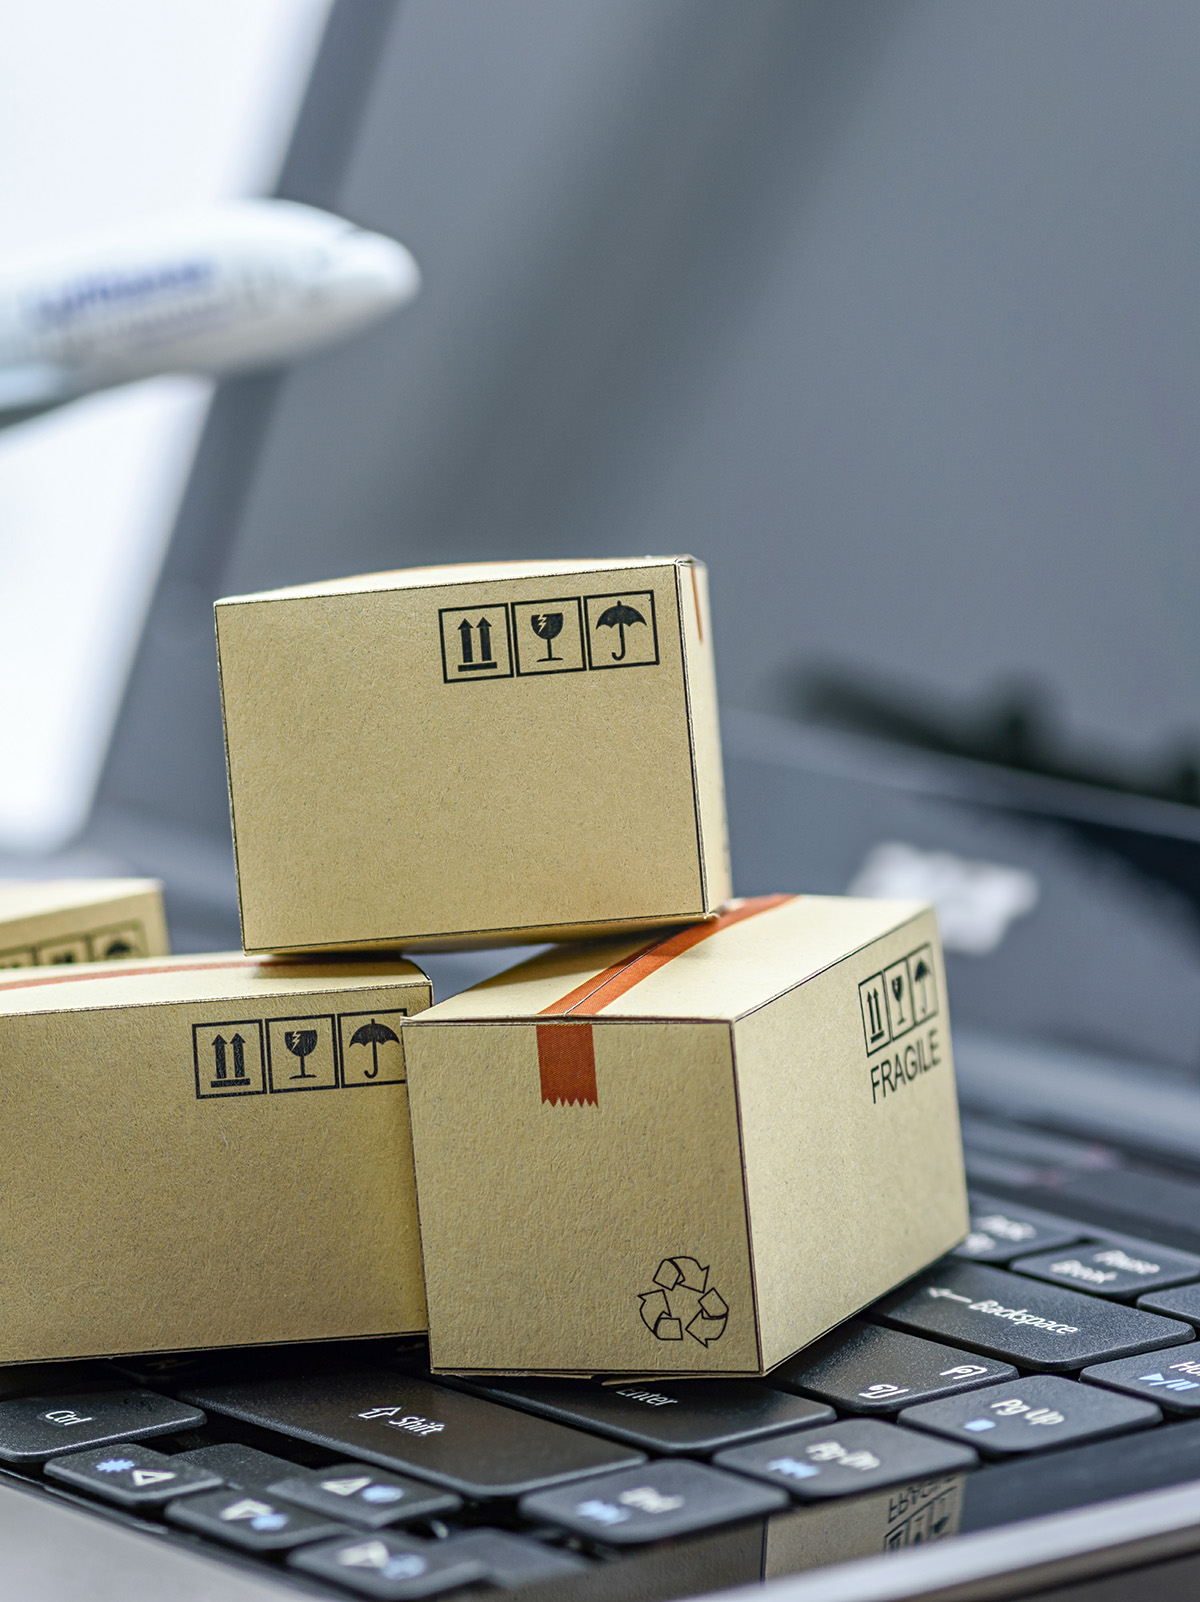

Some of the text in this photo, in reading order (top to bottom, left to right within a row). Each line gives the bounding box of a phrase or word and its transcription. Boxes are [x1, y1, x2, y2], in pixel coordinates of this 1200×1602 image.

[870, 1027, 941, 1105] FRAGILE
[968, 1299, 1079, 1334] Backspace
[45, 1410, 92, 1426] Ctrl
[990, 1399, 1065, 1425] Pg Up
[388, 1416, 445, 1435] Shift
